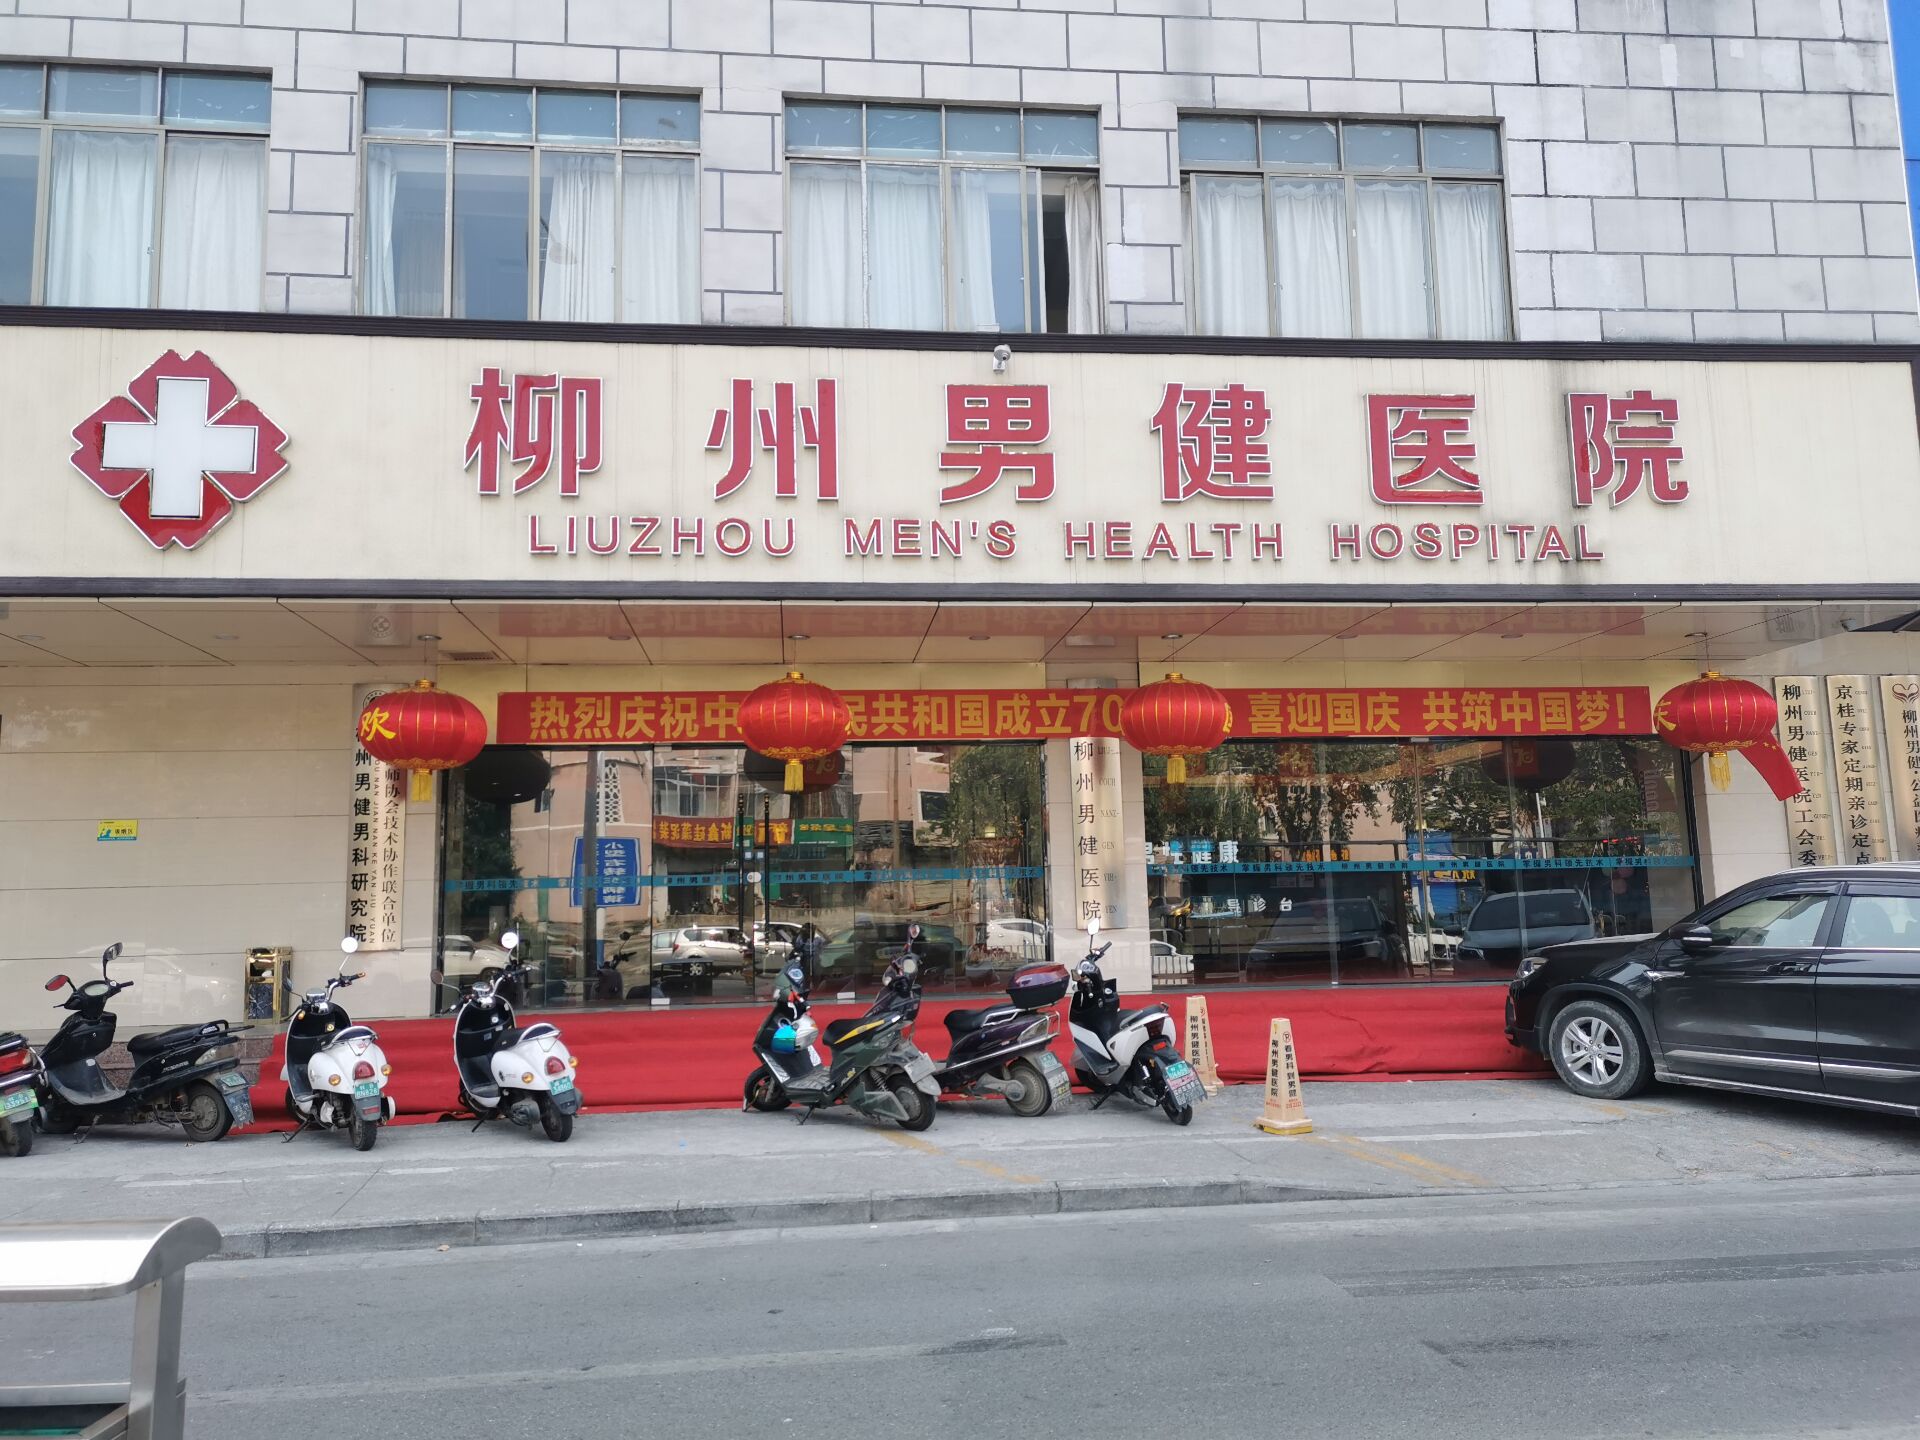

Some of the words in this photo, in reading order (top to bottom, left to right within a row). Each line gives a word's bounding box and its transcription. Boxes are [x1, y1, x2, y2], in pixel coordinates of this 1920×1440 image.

[464, 366, 1690, 508] 柳州男健医院
[529, 515, 796, 557] LIUZHOU
[844, 517, 1018, 559] MEN'S
[1064, 520, 1285, 561] HEALTH
[1330, 523, 1605, 563] HOSPITAL
[360, 706, 398, 741] 欢
[1248, 691, 1401, 735] 喜迎国庆
[1423, 689, 1627, 733] 共筑中国梦!
[381, 761, 401, 943] 师协会技术协作联合单位
[1074, 741, 1102, 921] 柳州男健医院
